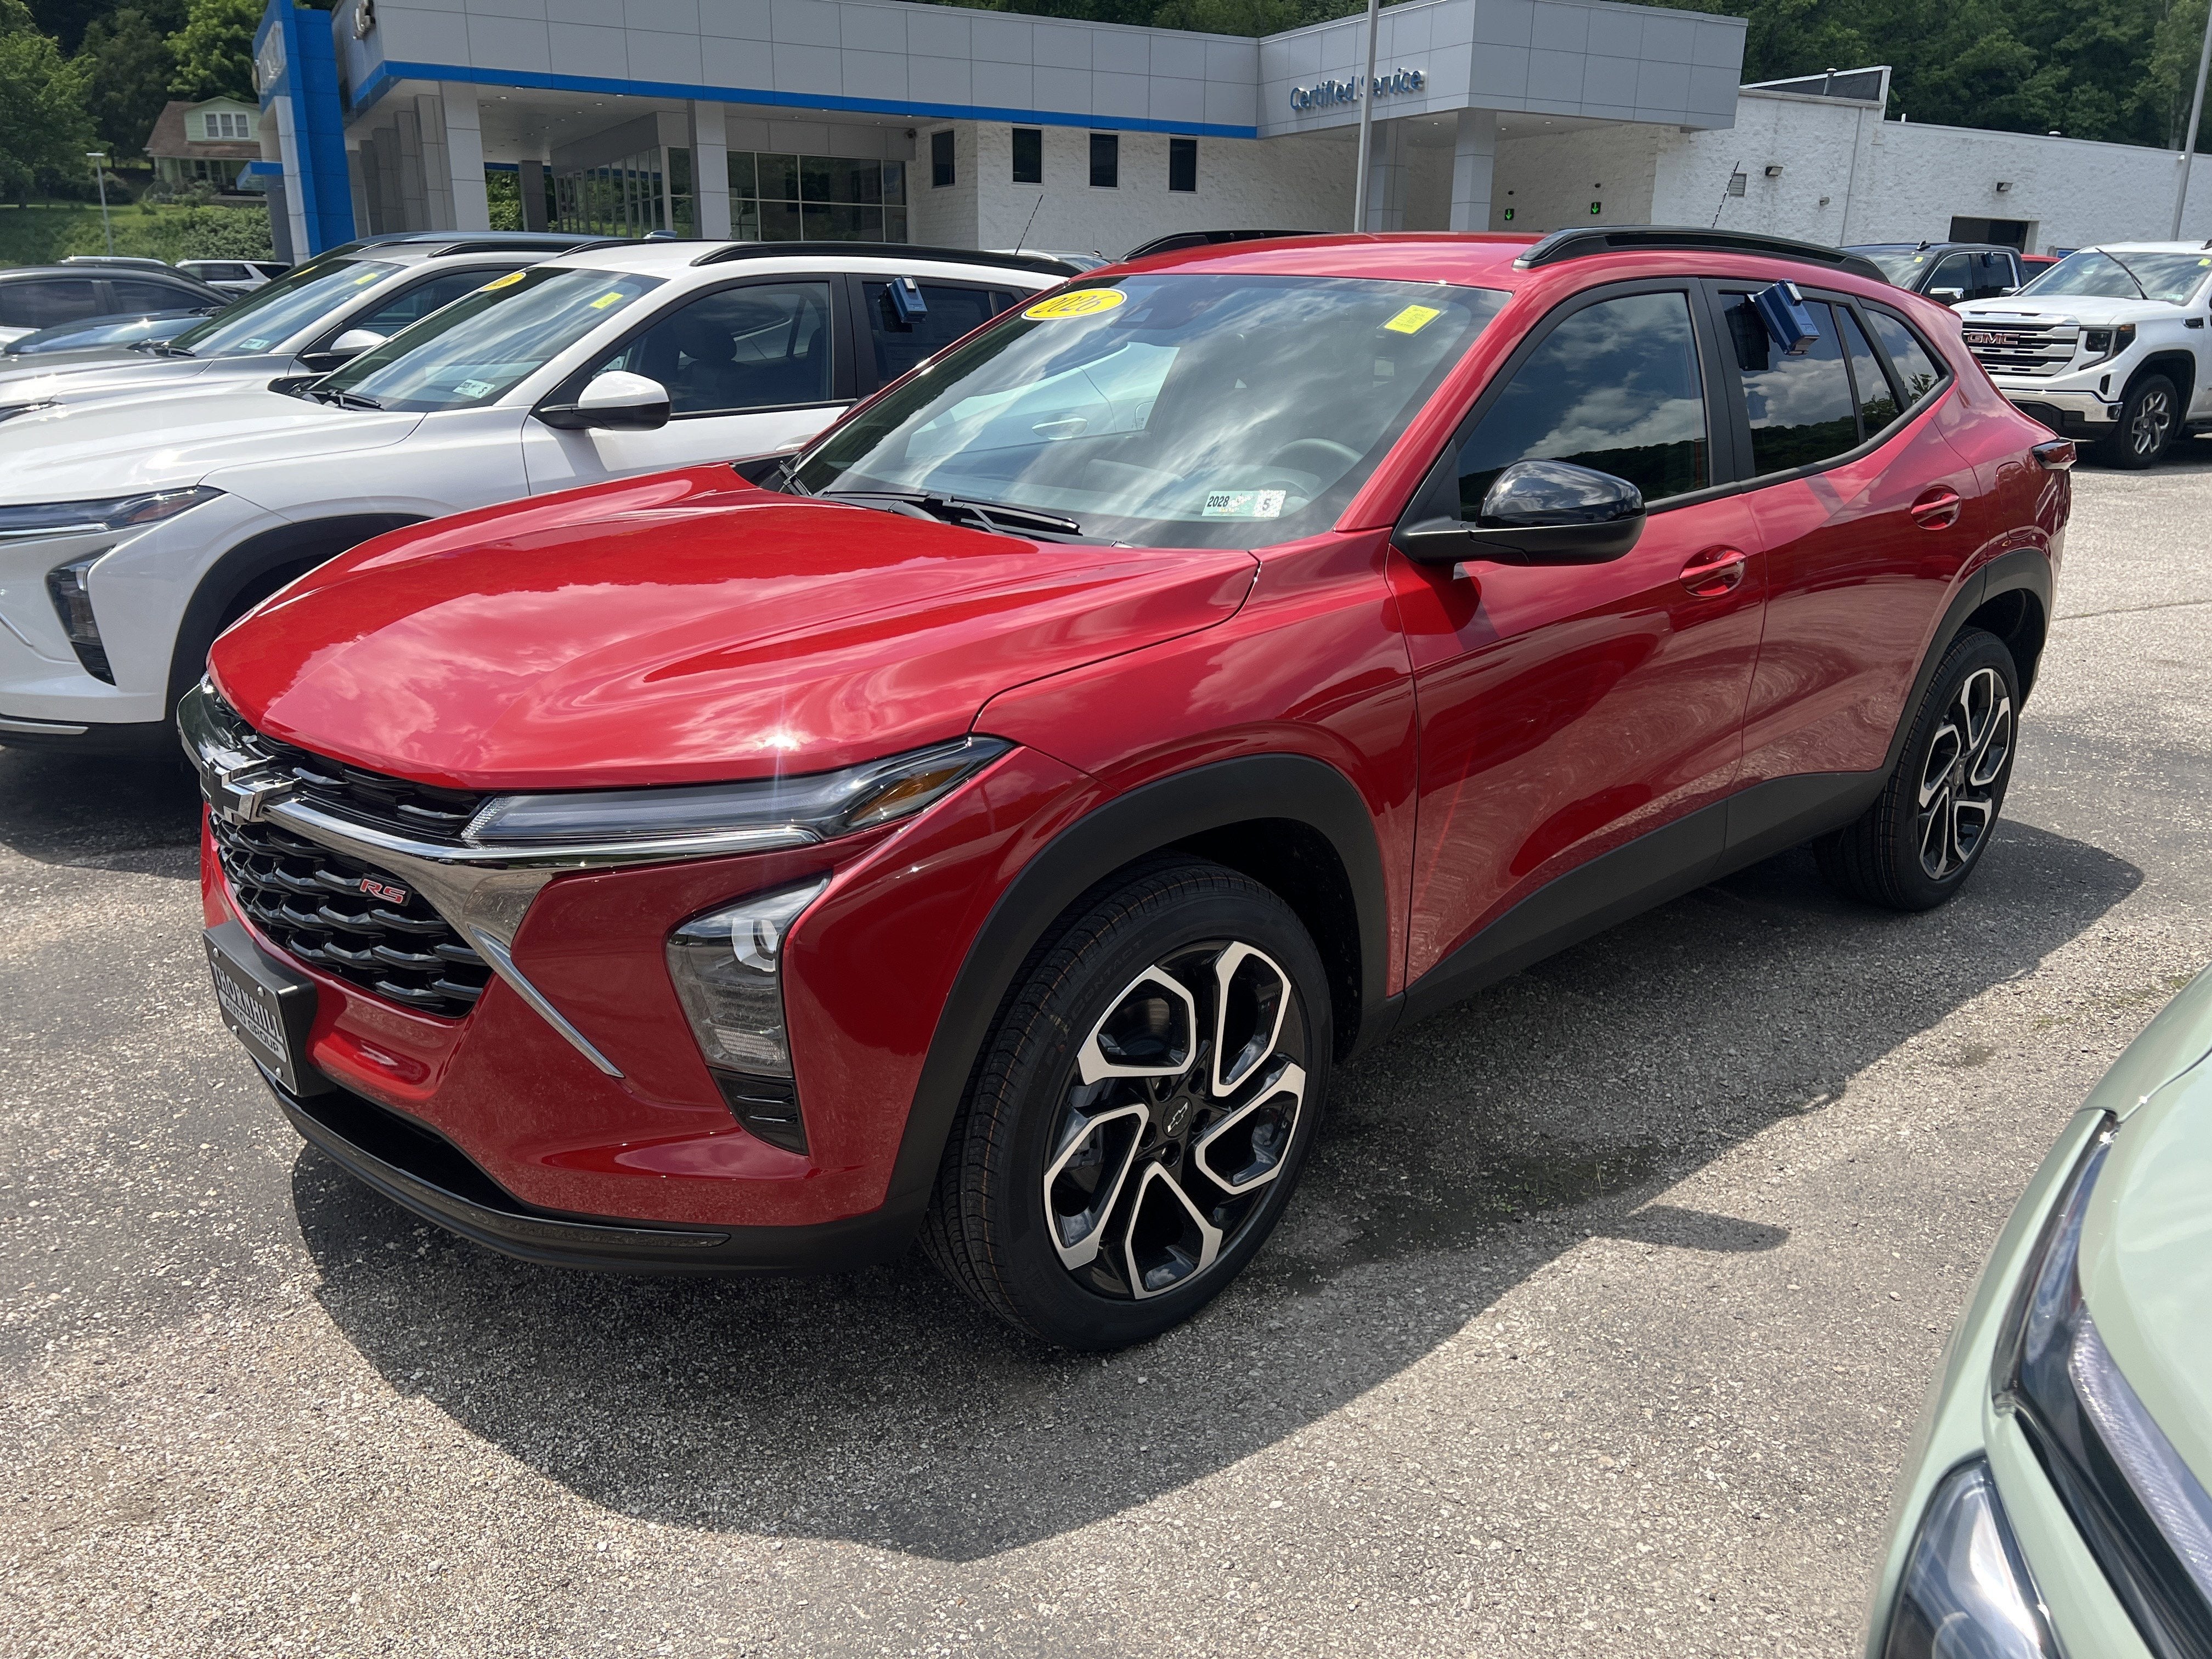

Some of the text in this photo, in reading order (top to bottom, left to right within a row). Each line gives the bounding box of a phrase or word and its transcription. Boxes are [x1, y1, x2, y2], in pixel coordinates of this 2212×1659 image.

[1290, 76, 1357, 111] Certified
[1031, 295, 1116, 314] 2026
[1967, 332, 2019, 345] GMC
[1206, 495, 1230, 507] 2028
[1262, 498, 1272, 511] 5
[359, 878, 406, 904] RS
[211, 960, 284, 1045] THORNHILL
[225, 997, 280, 1053] AUTO GROUP
